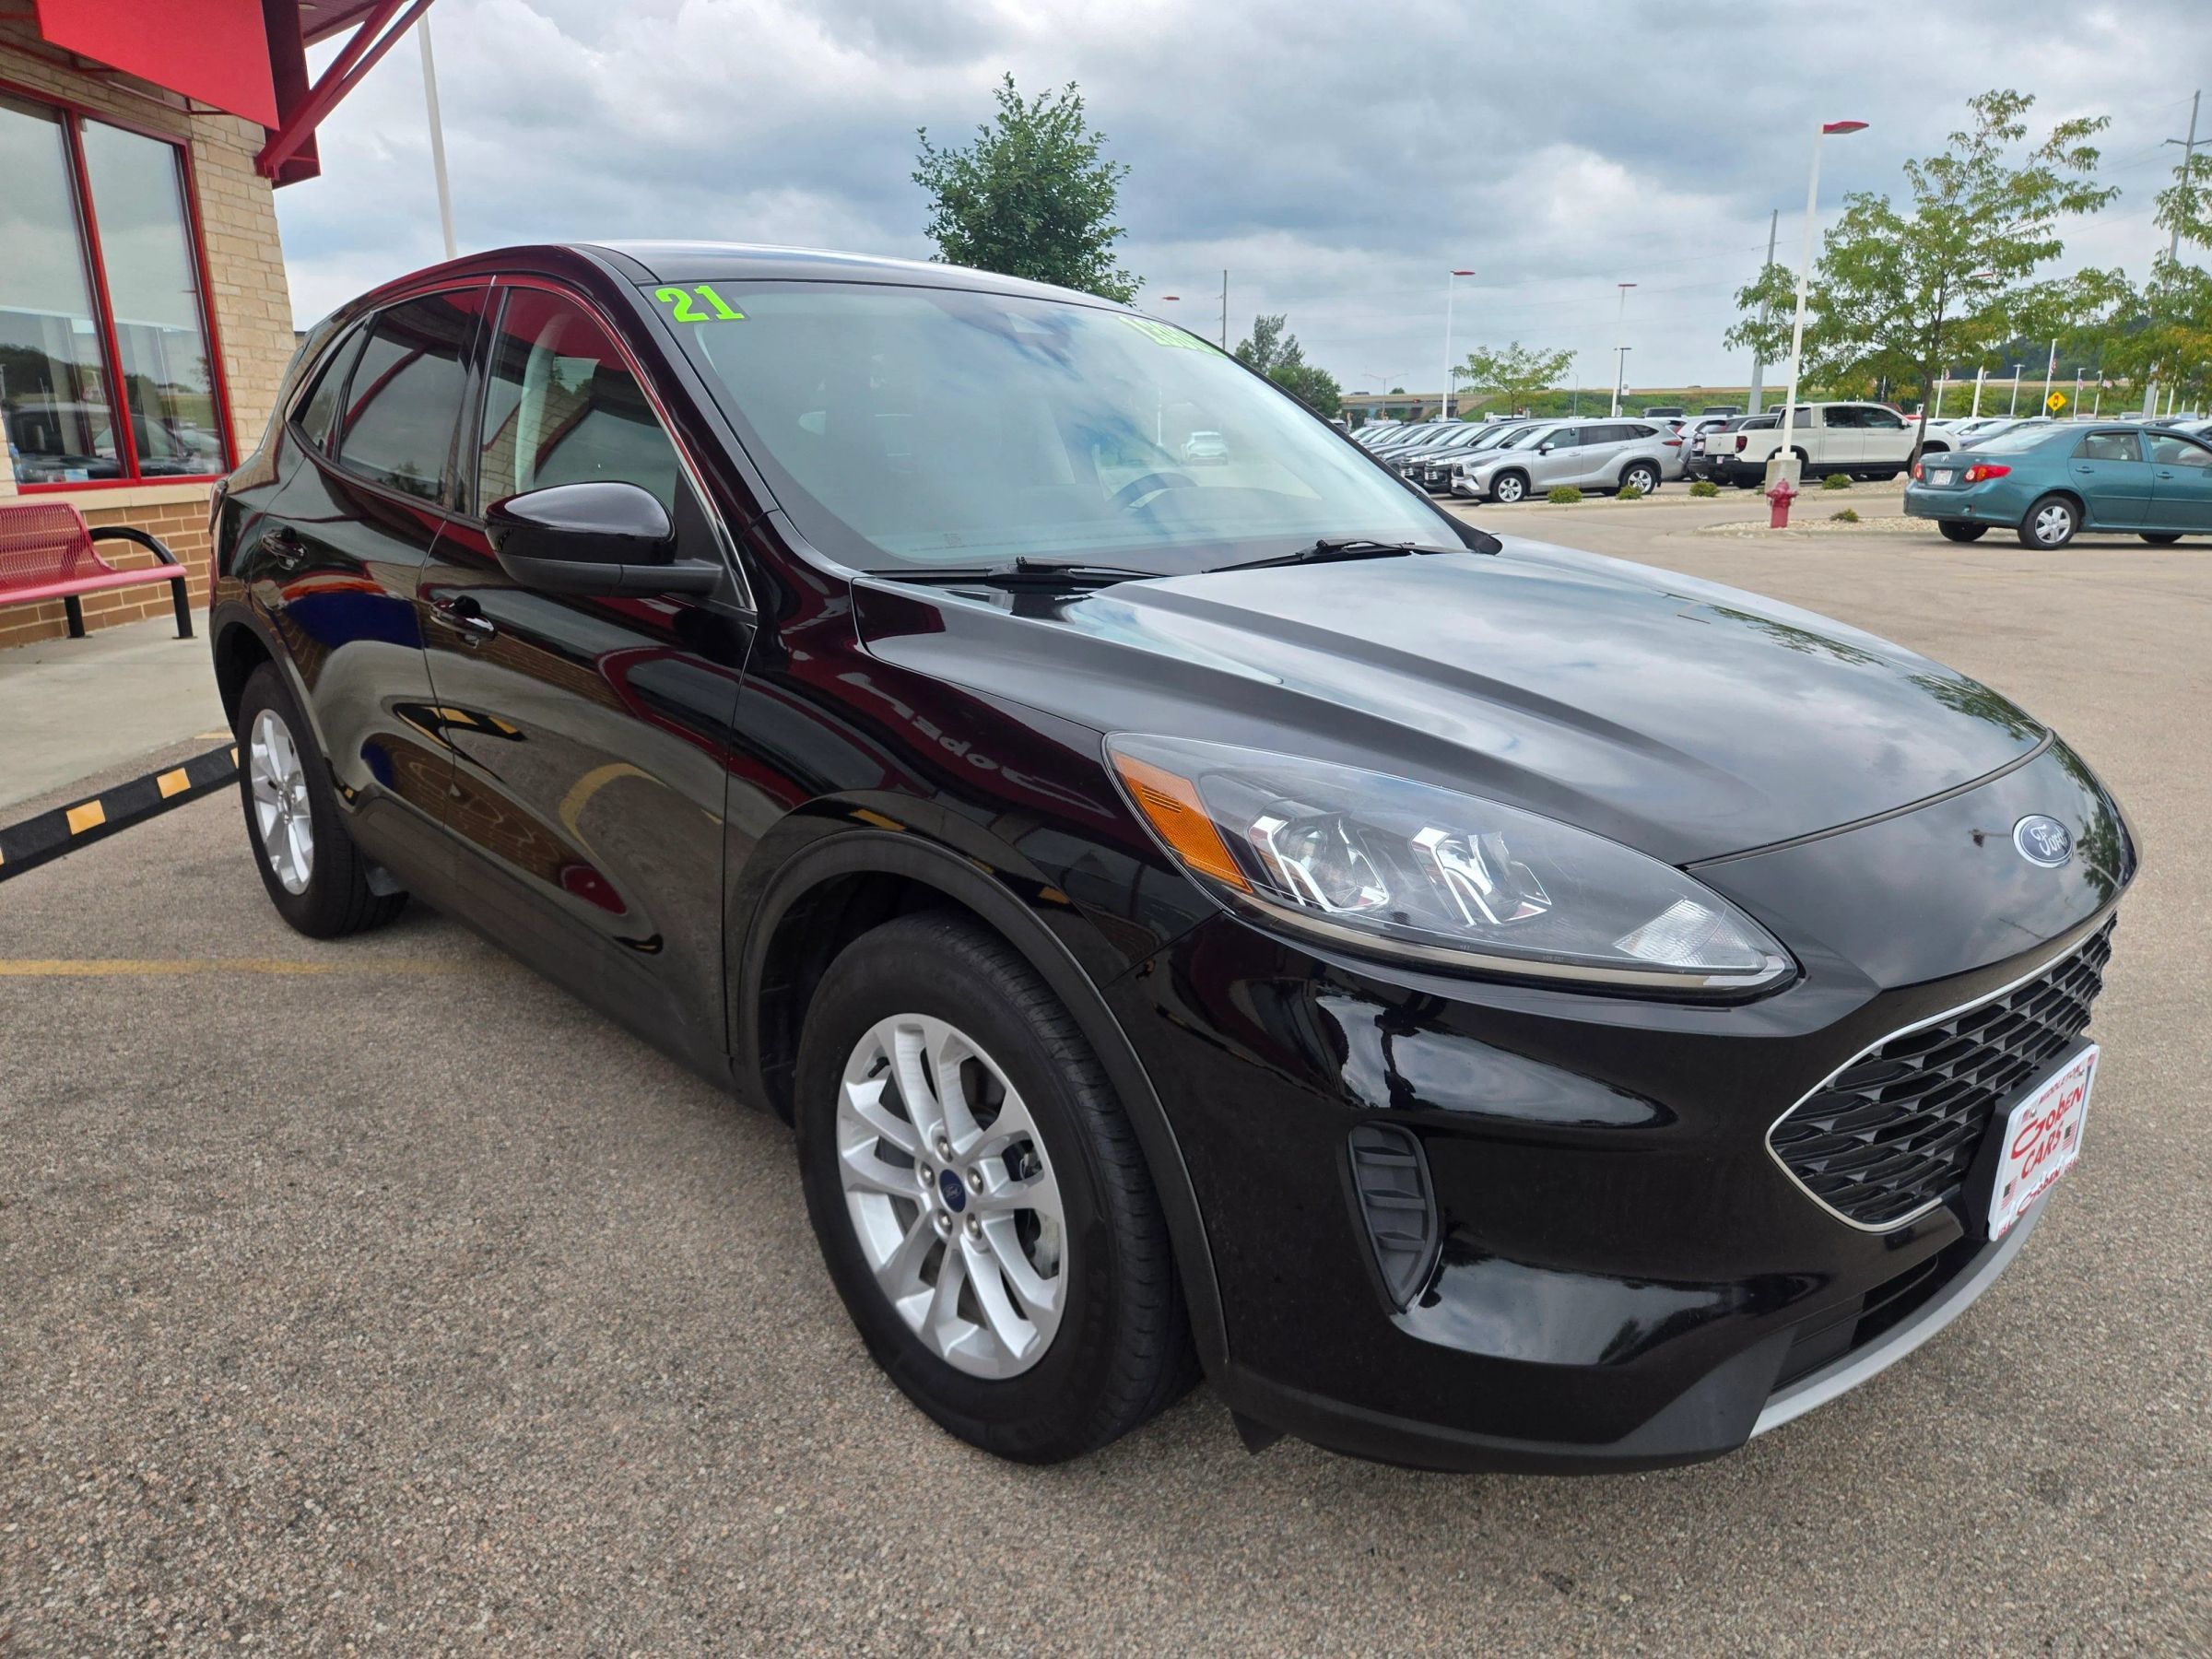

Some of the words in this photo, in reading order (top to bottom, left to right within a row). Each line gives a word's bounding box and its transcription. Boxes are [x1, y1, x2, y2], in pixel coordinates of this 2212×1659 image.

[655, 286, 745, 322] 21
[2030, 824, 2068, 856] Ford
[2021, 1120, 2064, 1180] CARS
